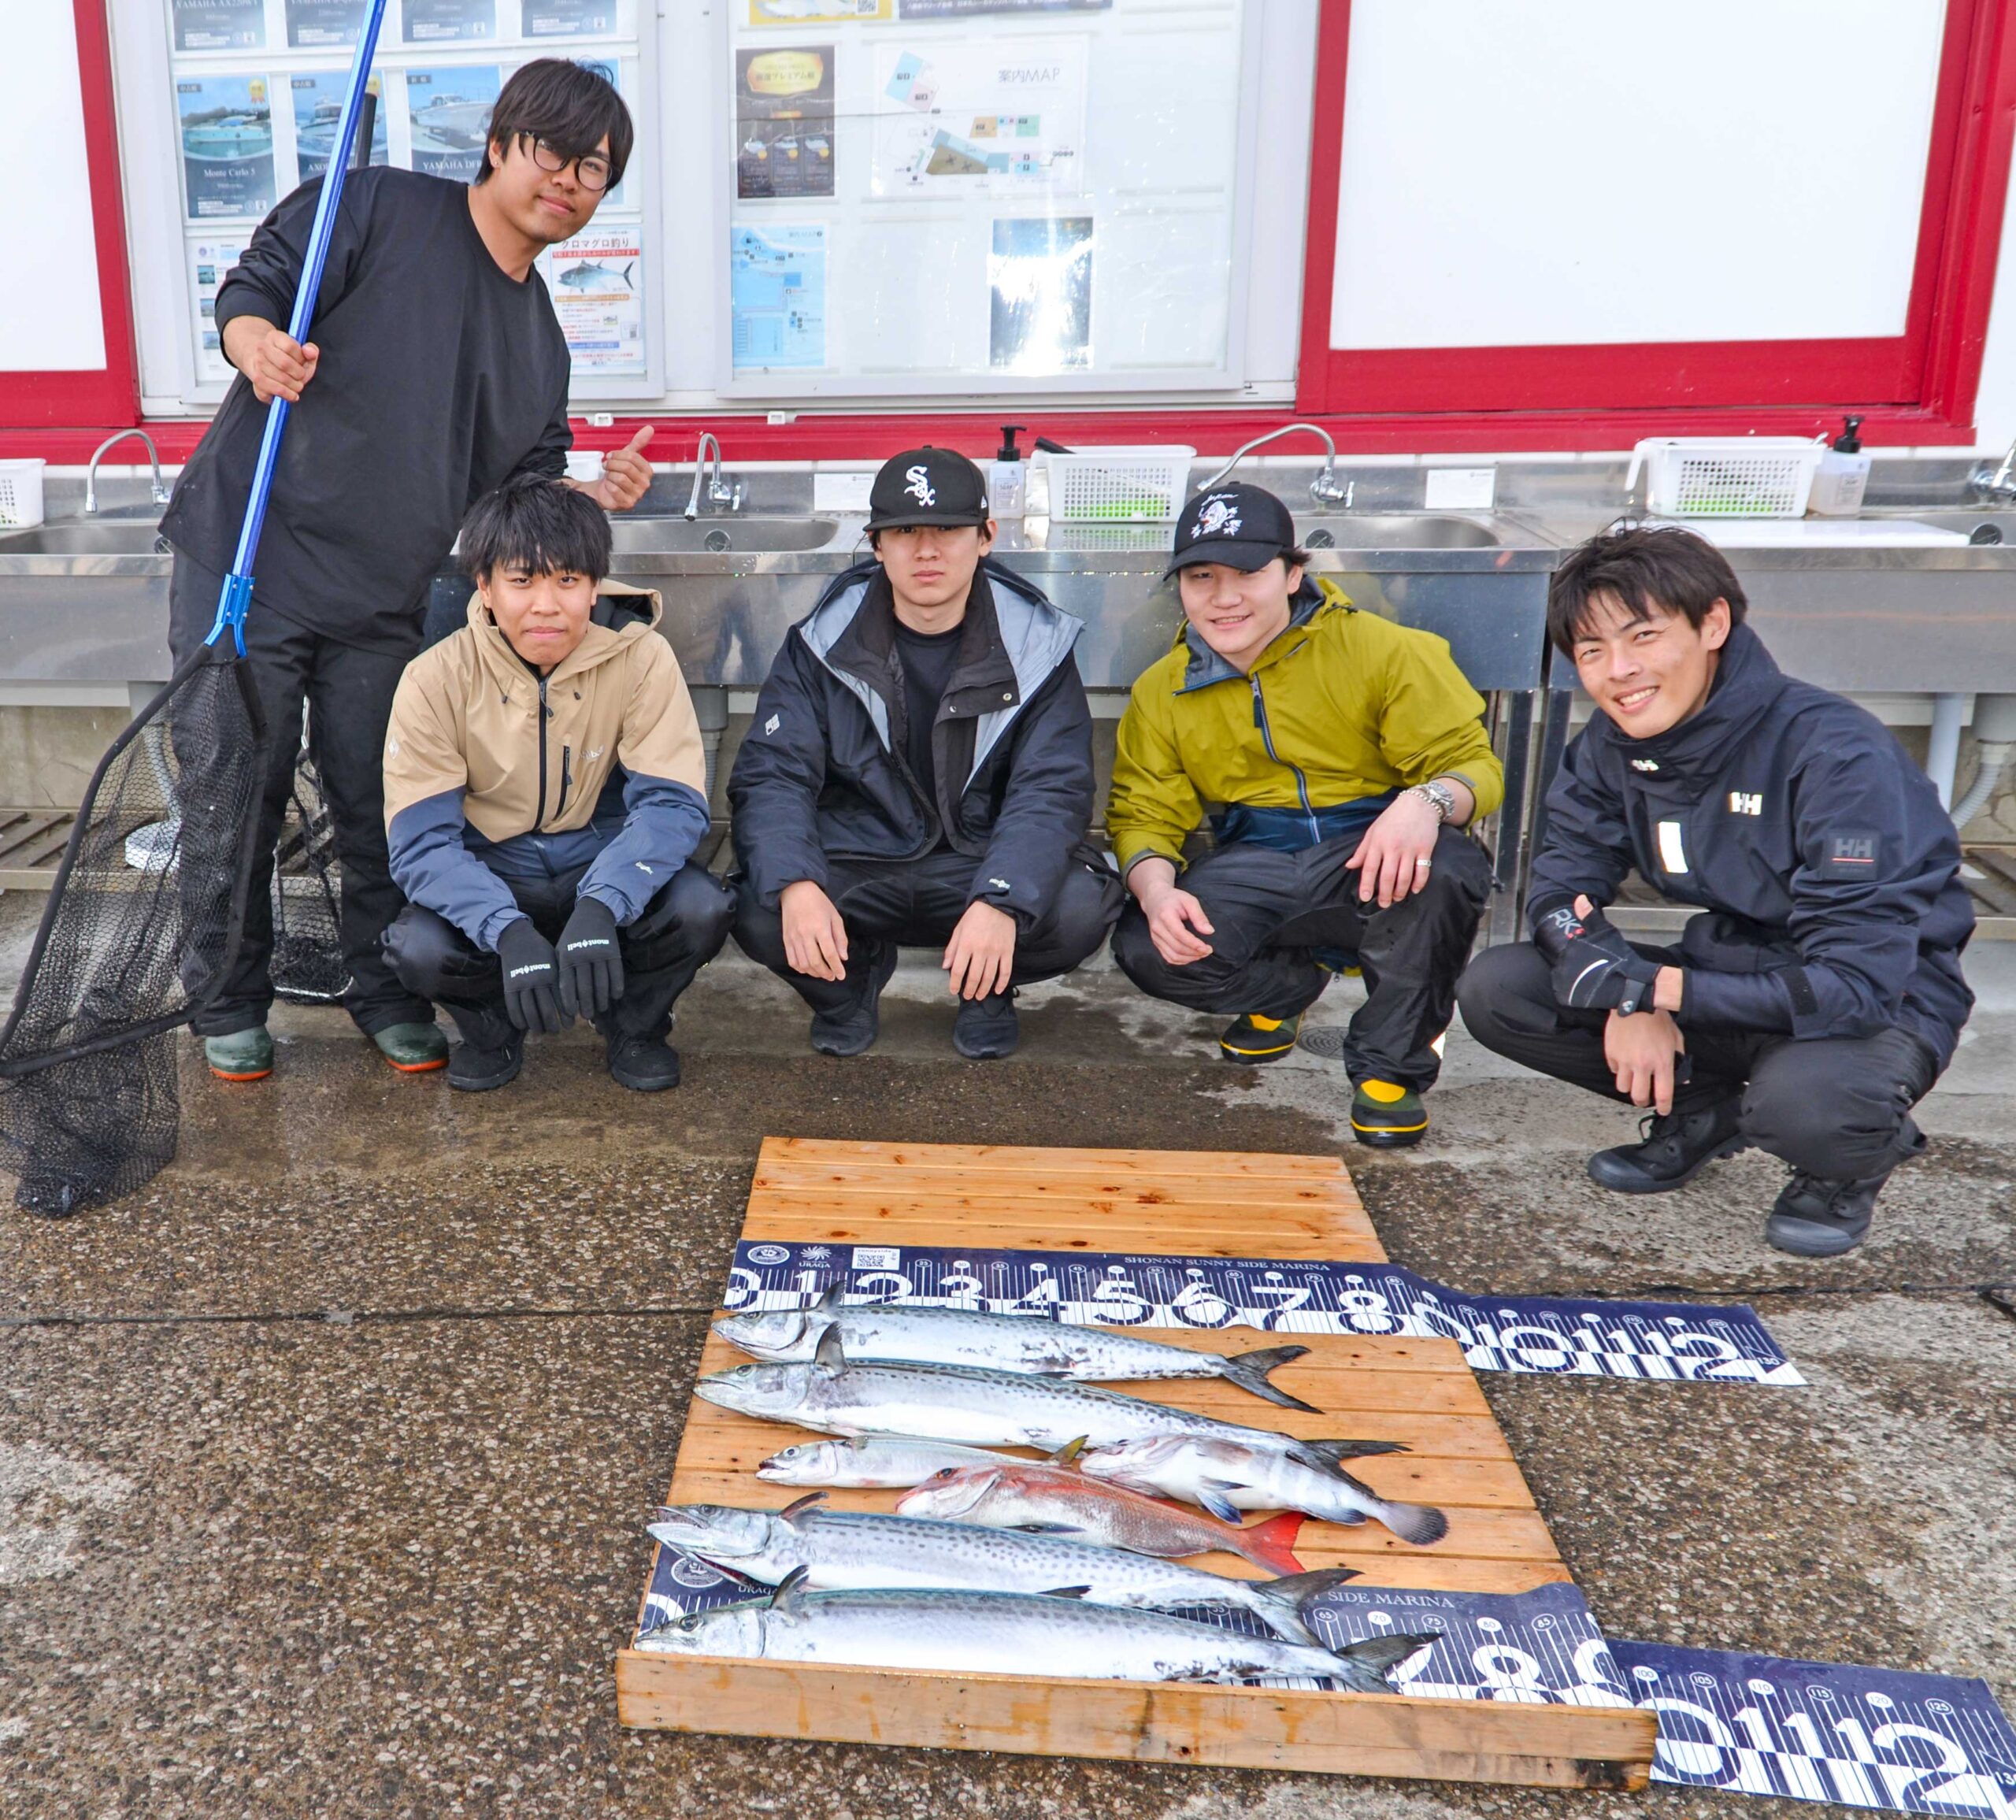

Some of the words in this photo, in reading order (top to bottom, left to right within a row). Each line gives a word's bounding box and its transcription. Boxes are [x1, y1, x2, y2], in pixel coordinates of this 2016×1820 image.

[203, 169, 227, 177] Monte
[228, 168, 249, 176] Carlo
[423, 160, 463, 170] YAMAHA
[1732, 791, 1762, 815] HH
[1835, 838, 1873, 858] HH
[1124, 1256, 1181, 1265] SHONAN
[1186, 1258, 1232, 1267] SUNNY
[1273, 1262, 1331, 1271] MARINA
[855, 1272, 913, 1305] 2
[940, 1275, 991, 1312] 3
[1011, 1277, 1069, 1324] 4
[1092, 1279, 1155, 1326] 5
[1172, 1281, 1239, 1329] 6
[1251, 1286, 1311, 1333] 7
[1339, 1289, 1405, 1336] 8
[1644, 1331, 1759, 1383] 12
[1756, 1356, 1781, 1366] 130
[1328, 1591, 1370, 1603] SIDE
[1374, 1593, 1455, 1608] MARINA
[1373, 1614, 1387, 1622] 70
[1537, 1618, 1551, 1628] 85
[1473, 1644, 1567, 1704] 8
[1636, 1669, 1655, 1679] 100
[1692, 1675, 1713, 1686] 105
[1751, 1682, 1770, 1692] 110
[1810, 1688, 1832, 1699] 115
[1870, 1695, 1890, 1706] 120
[1929, 1700, 1950, 1712] 125
[1995, 1770, 2016, 1787] 13
